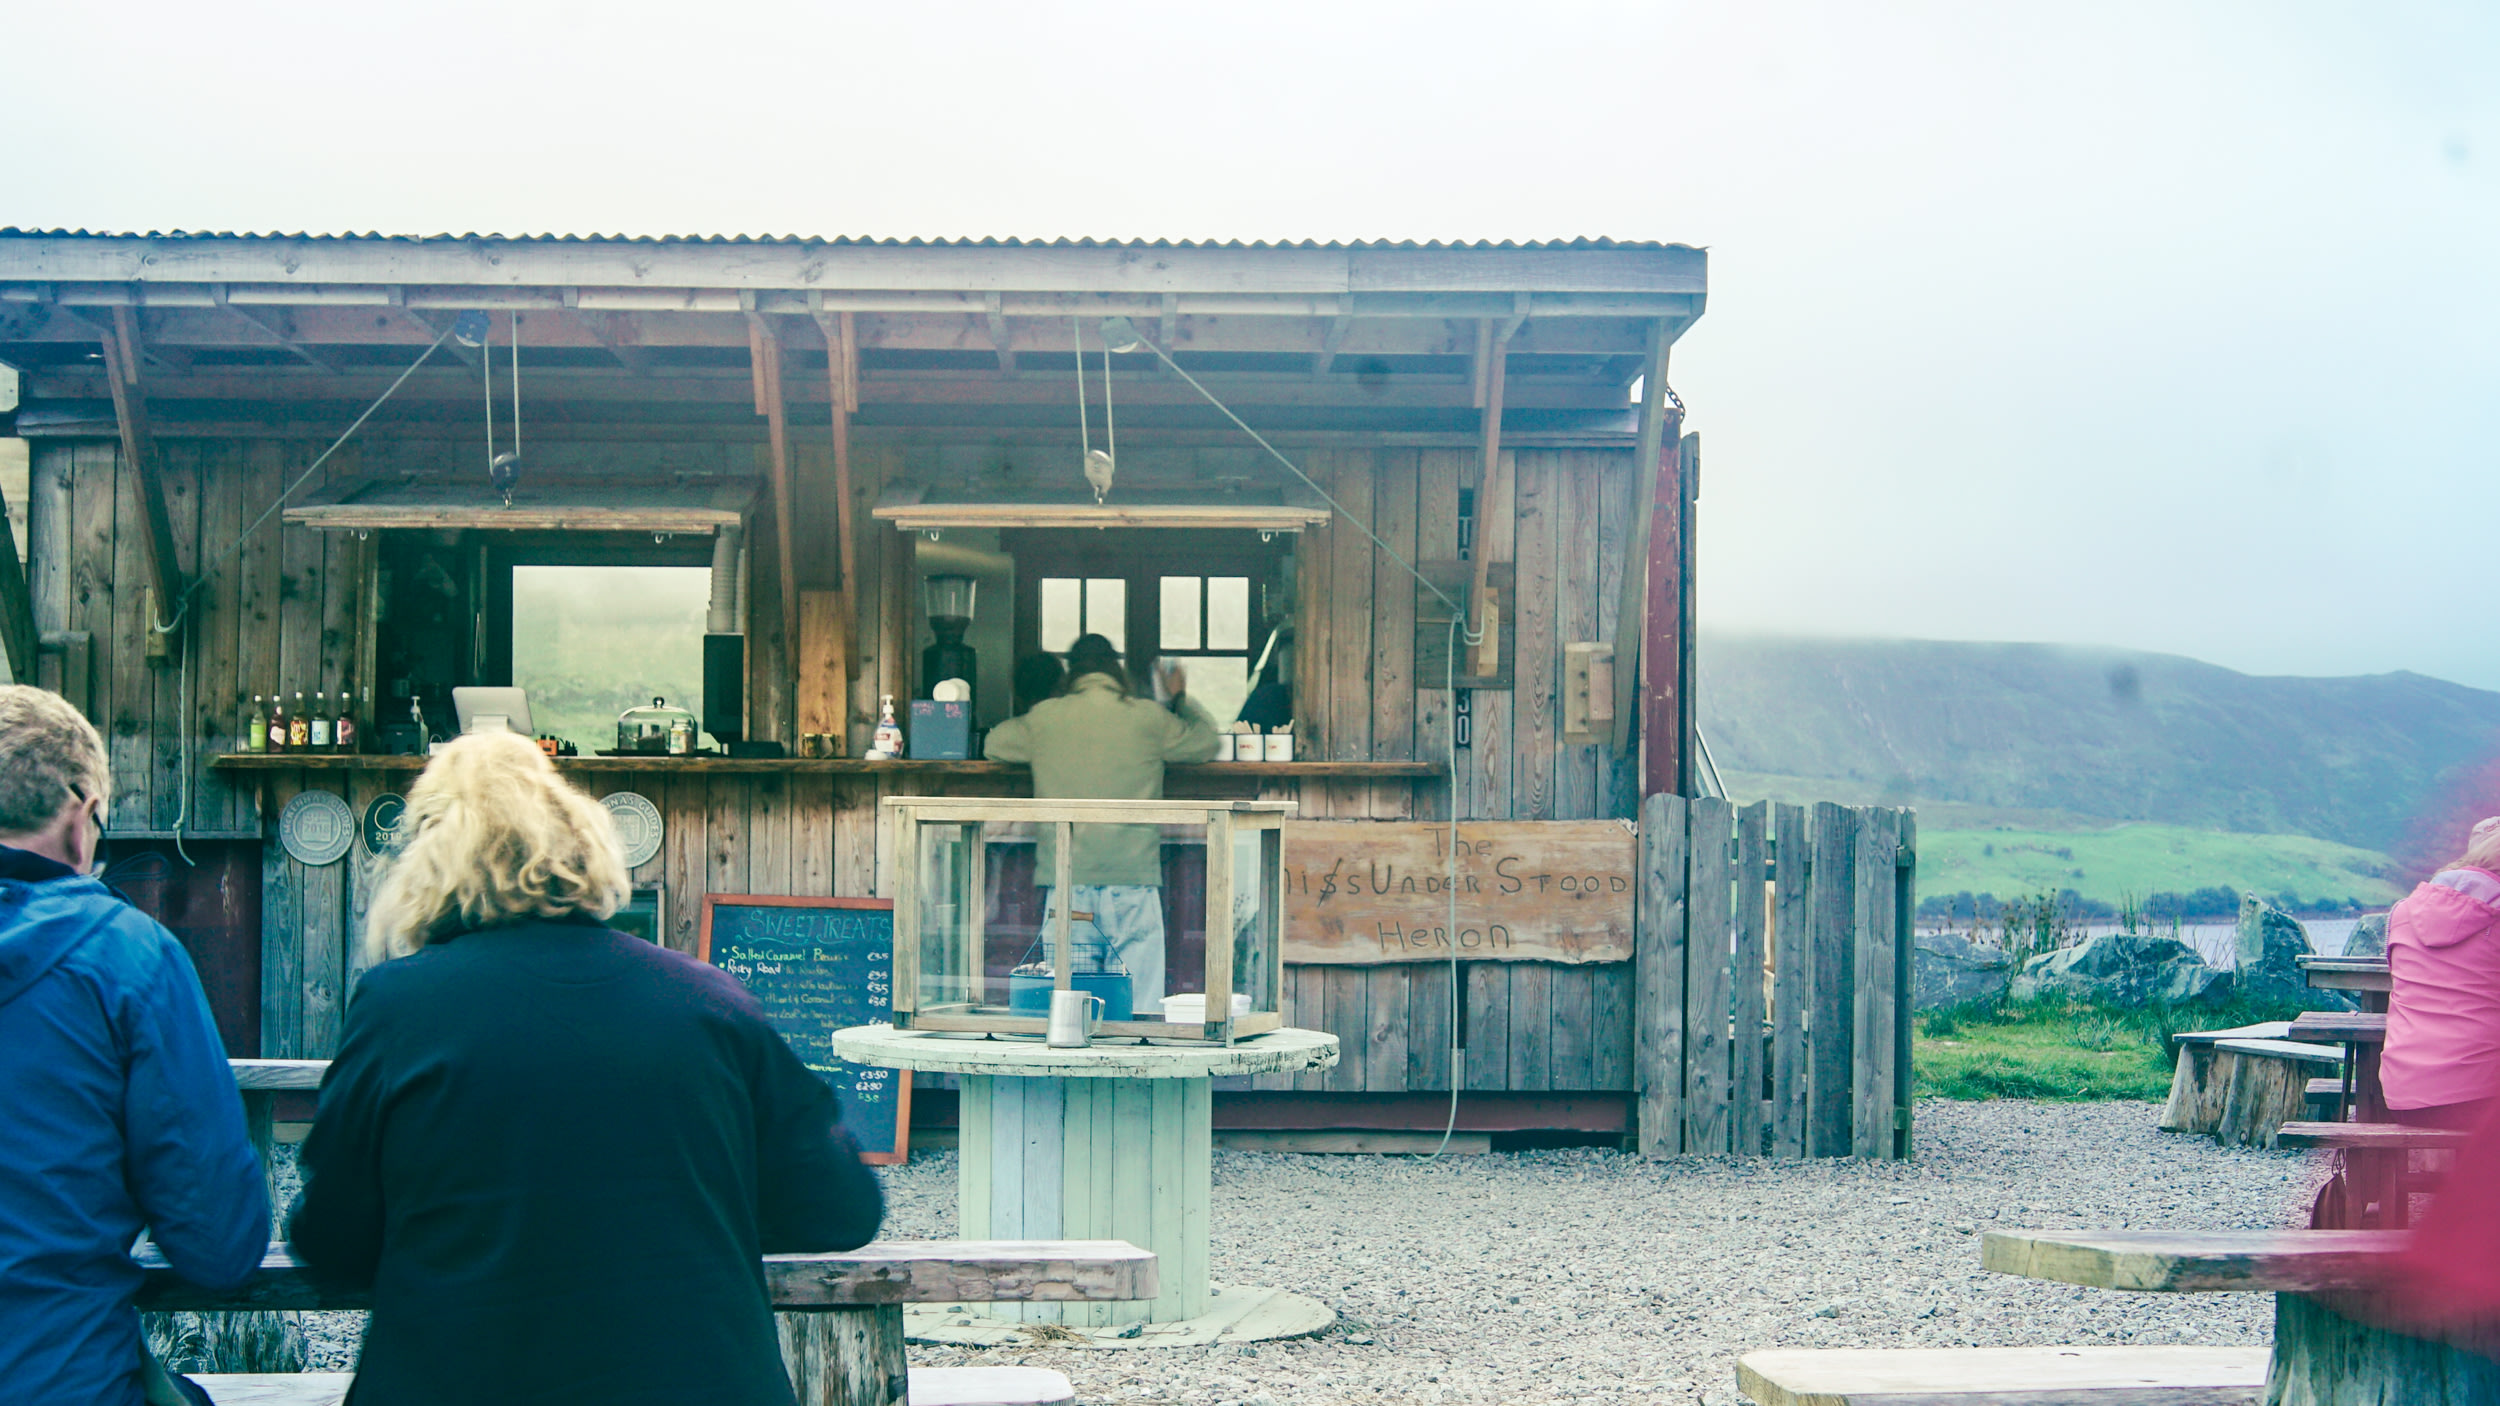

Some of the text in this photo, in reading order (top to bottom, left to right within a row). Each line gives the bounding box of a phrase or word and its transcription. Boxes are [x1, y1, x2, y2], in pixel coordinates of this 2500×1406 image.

[638, 801, 660, 839] GUIDES
[1423, 827, 1492, 857] The
[744, 909, 893, 943] SWEET TREATS
[731, 945, 765, 961] Salted
[727, 958, 752, 982] Rocky
[757, 961, 781, 975] Road
